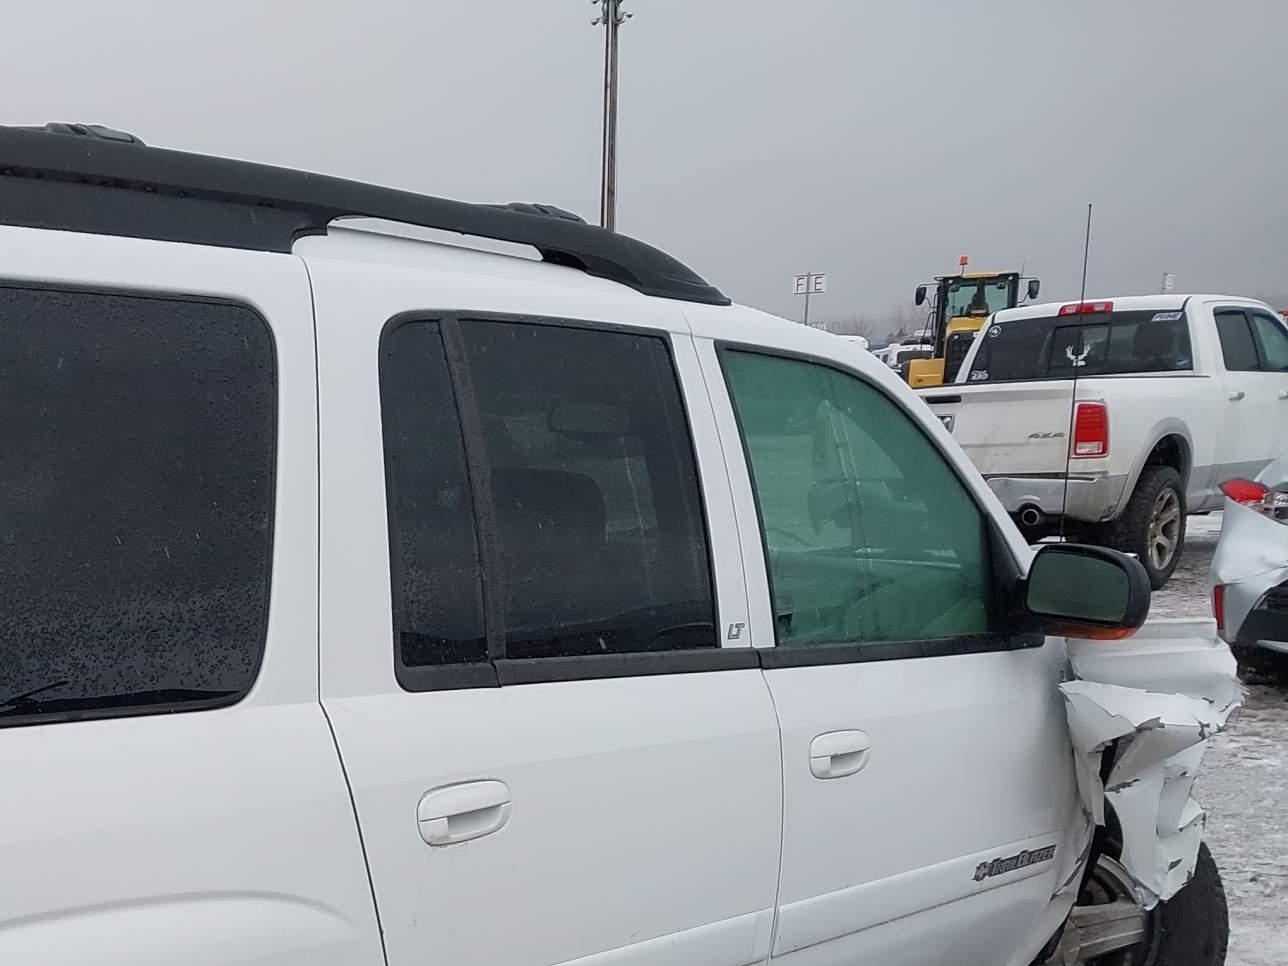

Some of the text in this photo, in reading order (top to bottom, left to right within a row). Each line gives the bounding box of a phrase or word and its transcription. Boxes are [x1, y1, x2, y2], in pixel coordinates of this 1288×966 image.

[796, 276, 824, 293] F E
[727, 622, 746, 640] LT
